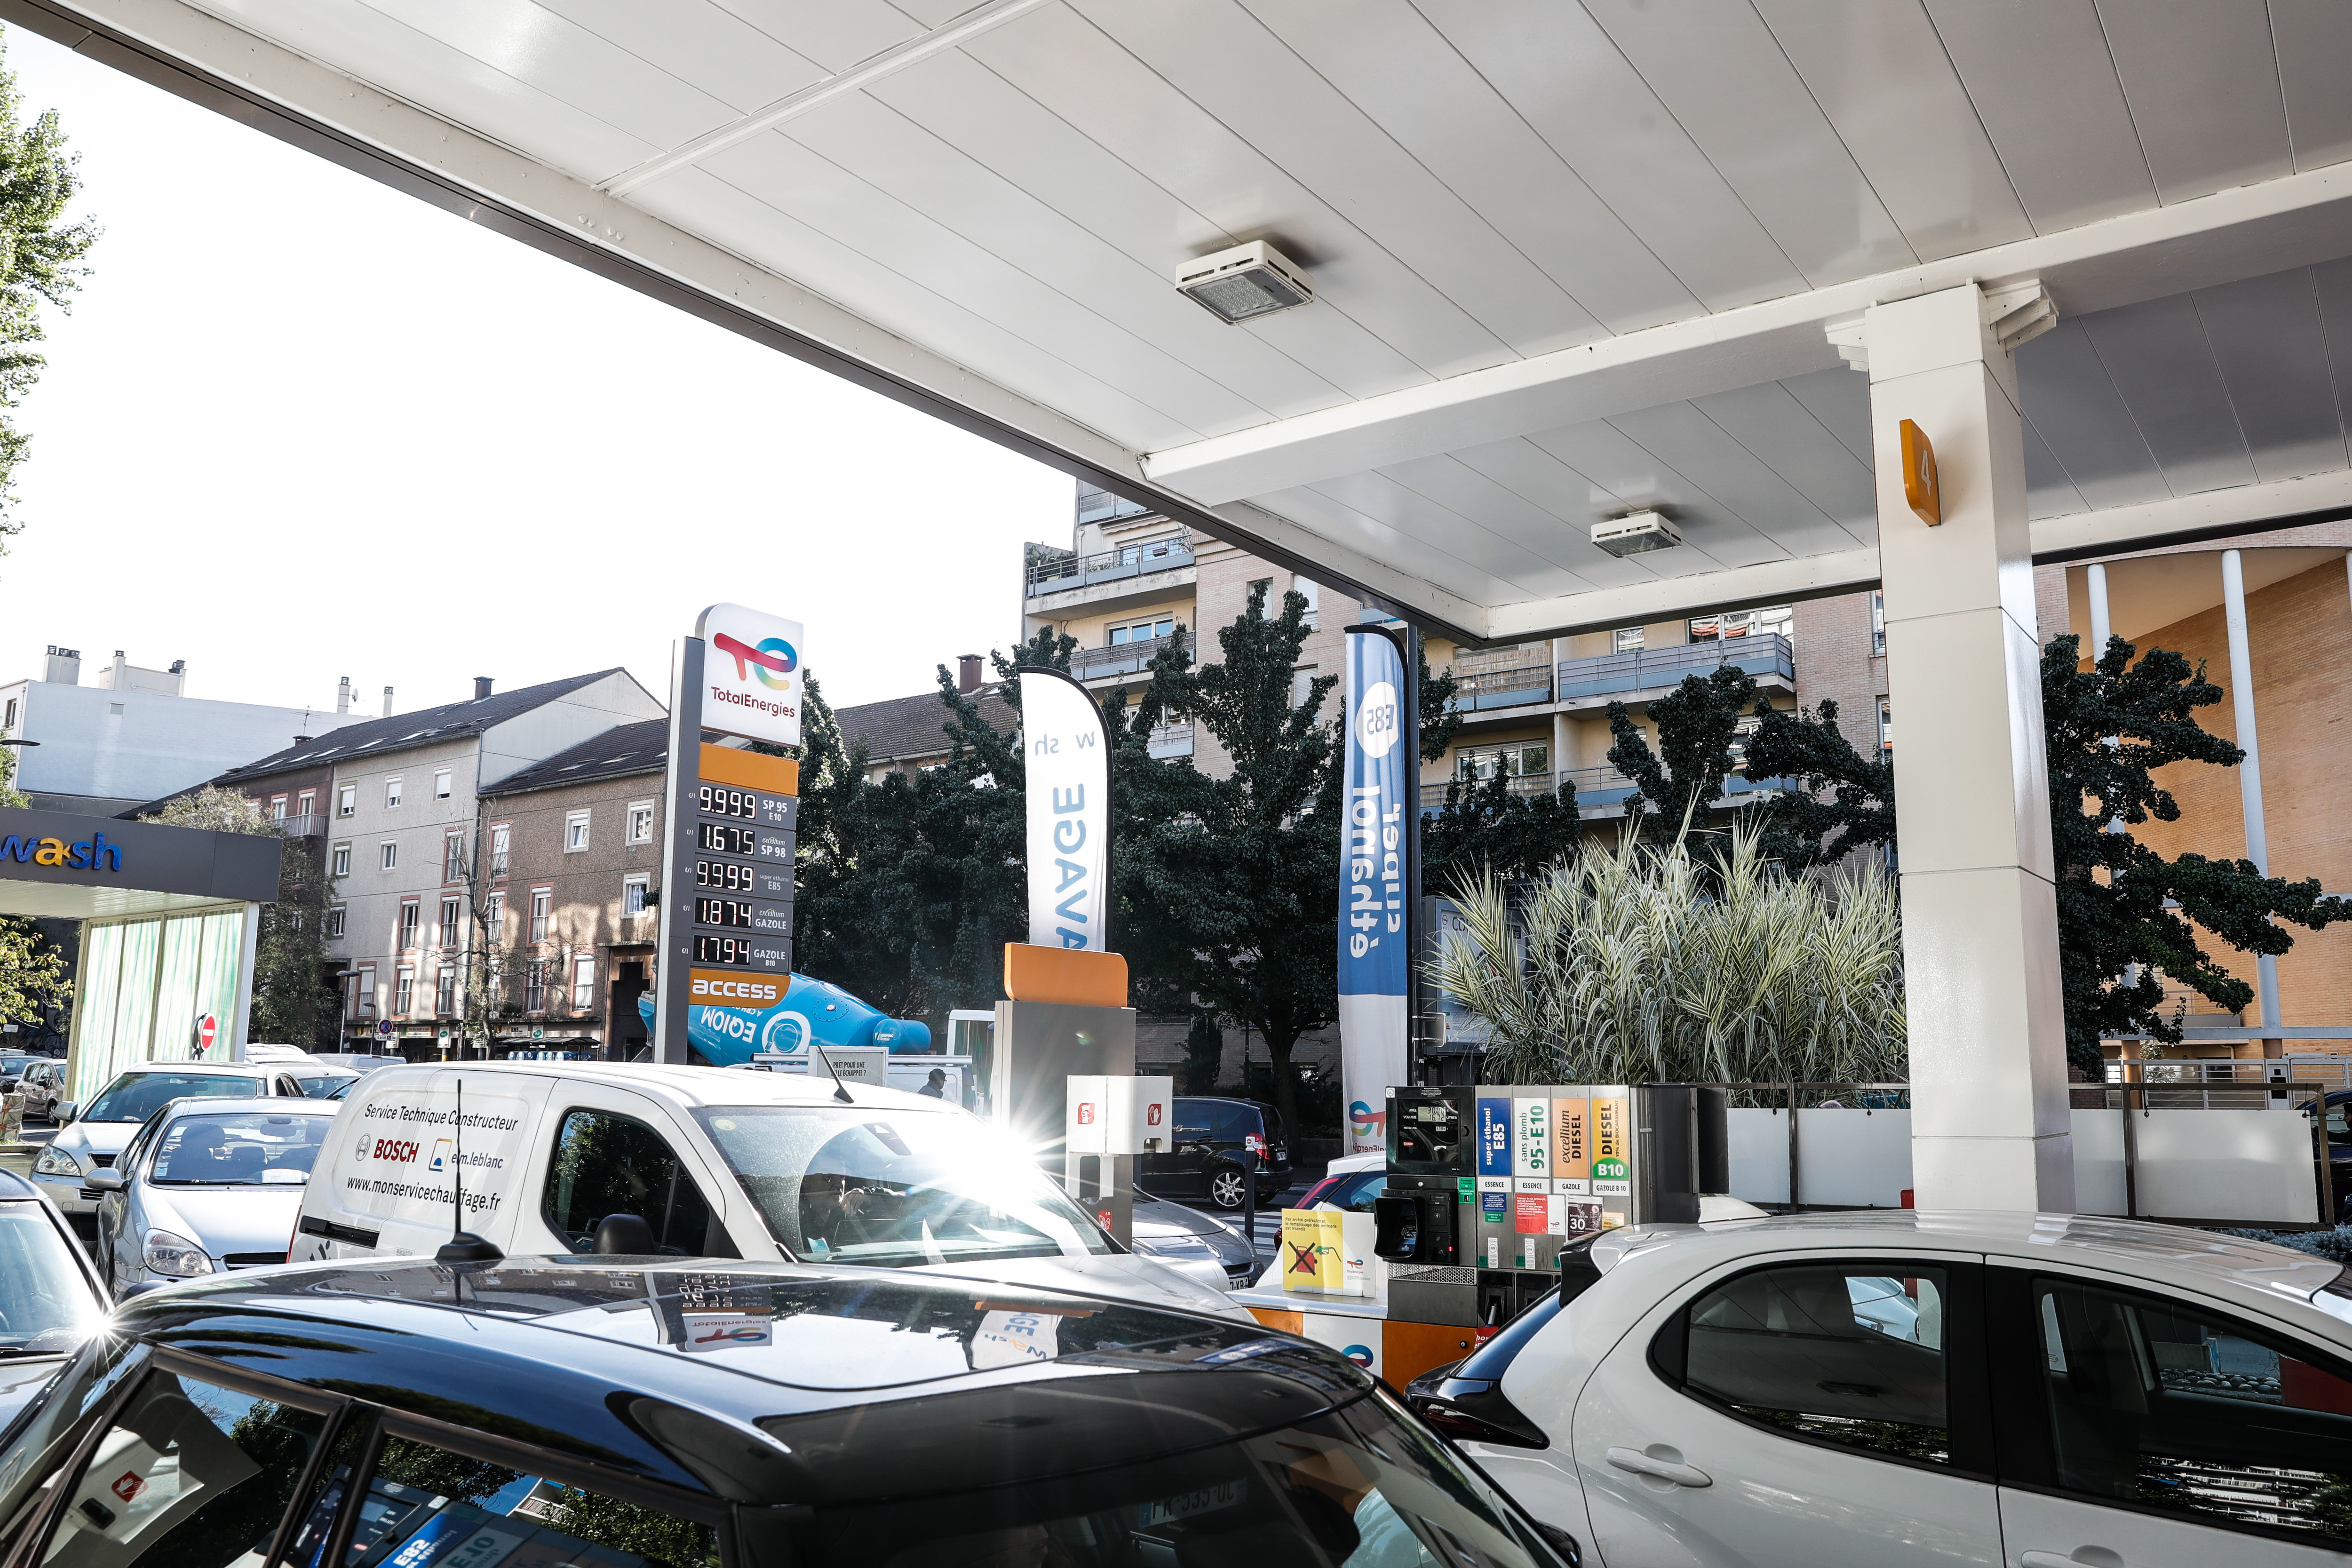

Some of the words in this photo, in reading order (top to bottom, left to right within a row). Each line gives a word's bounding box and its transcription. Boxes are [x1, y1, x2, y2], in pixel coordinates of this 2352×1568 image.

[1921, 449, 1931, 497] 4
[711, 686, 795, 717] TotalEnergies
[700, 786, 755, 819] 9.999
[763, 799, 774, 811] SP
[776, 802, 787, 813] 95
[769, 812, 781, 821] E10
[0, 831, 122, 871] wash
[706, 826, 754, 854] 1.675
[761, 845, 773, 856] SP
[775, 847, 786, 858] 98
[762, 837, 785, 846] excellium
[697, 861, 753, 891] 9.999
[768, 882, 781, 891] E85
[703, 900, 752, 926] 1.874
[755, 918, 787, 930] GAZOLE
[759, 908, 785, 918] excellium
[700, 938, 750, 963] 1.794
[754, 949, 786, 960] GAZOLE
[700, 1006, 757, 1043] EQIOM
[833, 1060, 843, 1068] PRÊT
[365, 1103, 397, 1119] Service
[399, 1106, 446, 1126] Technique
[448, 1110, 519, 1131] Constructeur
[1519, 1112, 1528, 1140] plomb
[1601, 1104, 1613, 1155] DIESEL
[1493, 1123, 1505, 1150] E85
[1560, 1110, 1571, 1163] excellium
[1572, 1114, 1581, 1160] DIESEL
[373, 1138, 420, 1163] BOSCH
[451, 1150, 504, 1169] em.leblanc
[1597, 1163, 1624, 1177] B10
[1570, 1218, 1586, 1230] 30
